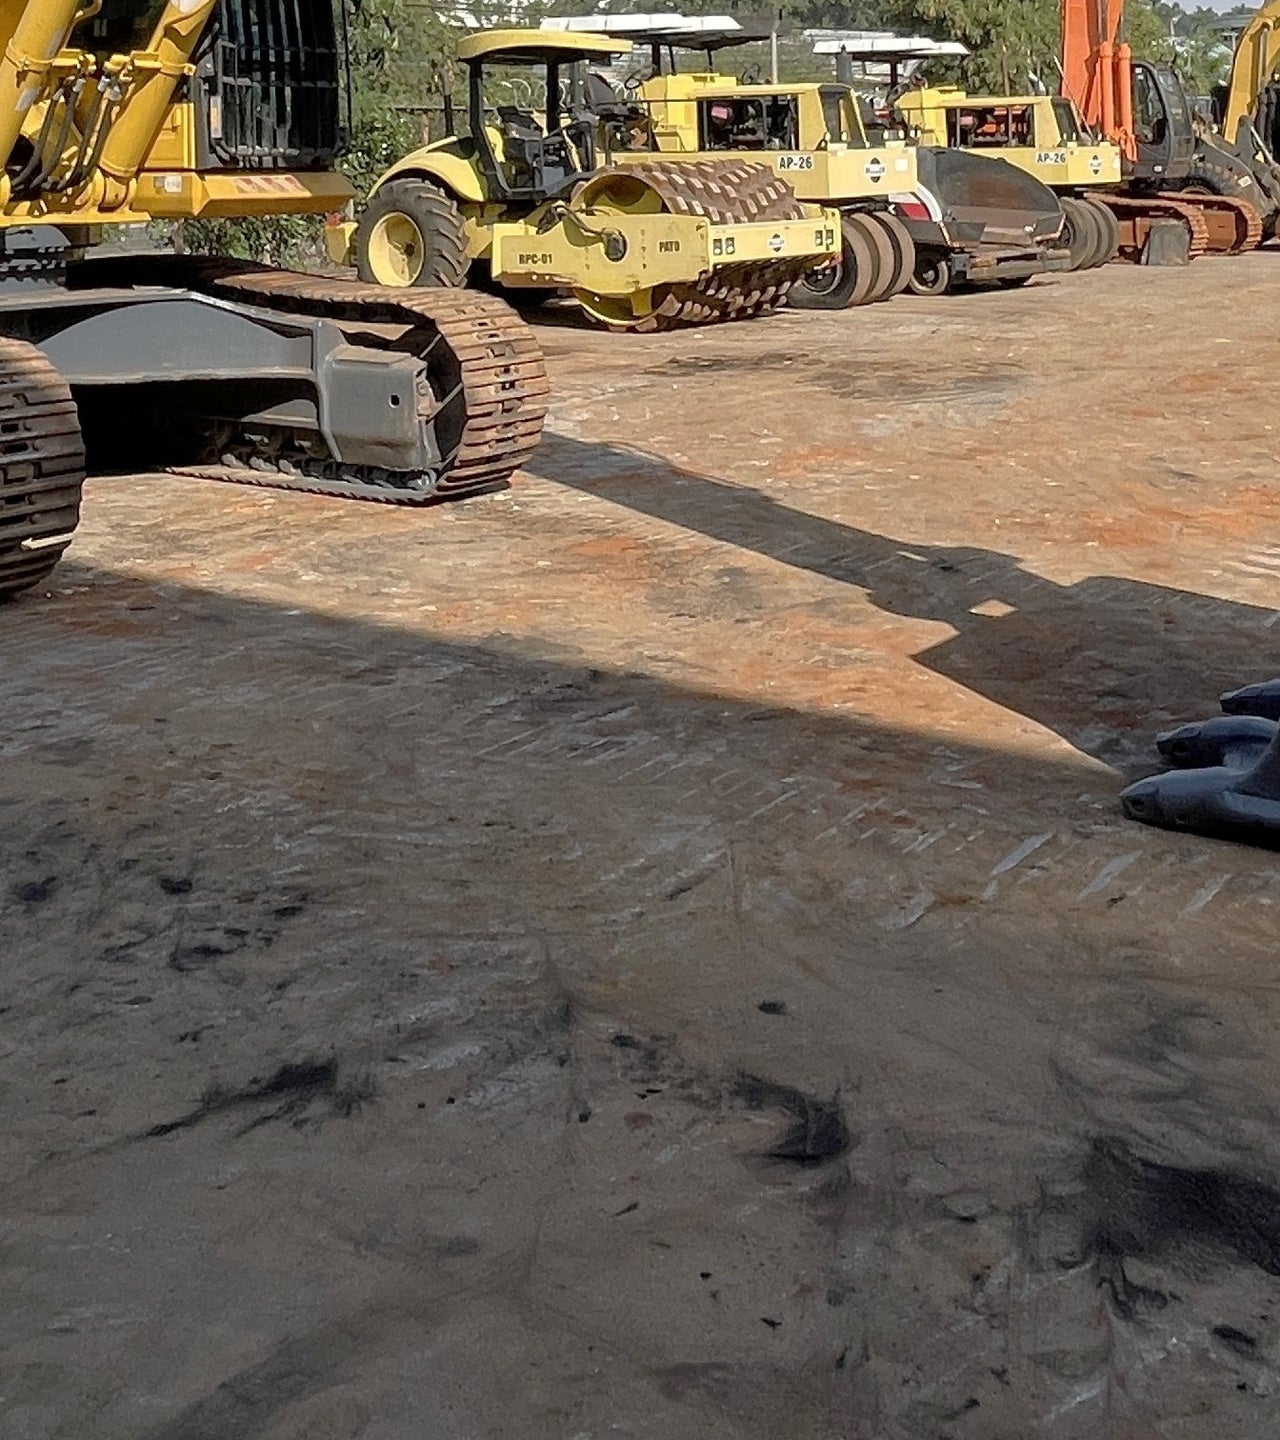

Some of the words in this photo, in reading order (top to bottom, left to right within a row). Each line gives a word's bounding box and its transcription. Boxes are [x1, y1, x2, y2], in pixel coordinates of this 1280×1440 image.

[779, 156, 813, 170] AP-26
[1037, 153, 1067, 164] AP-26
[659, 240, 680, 253] PATO
